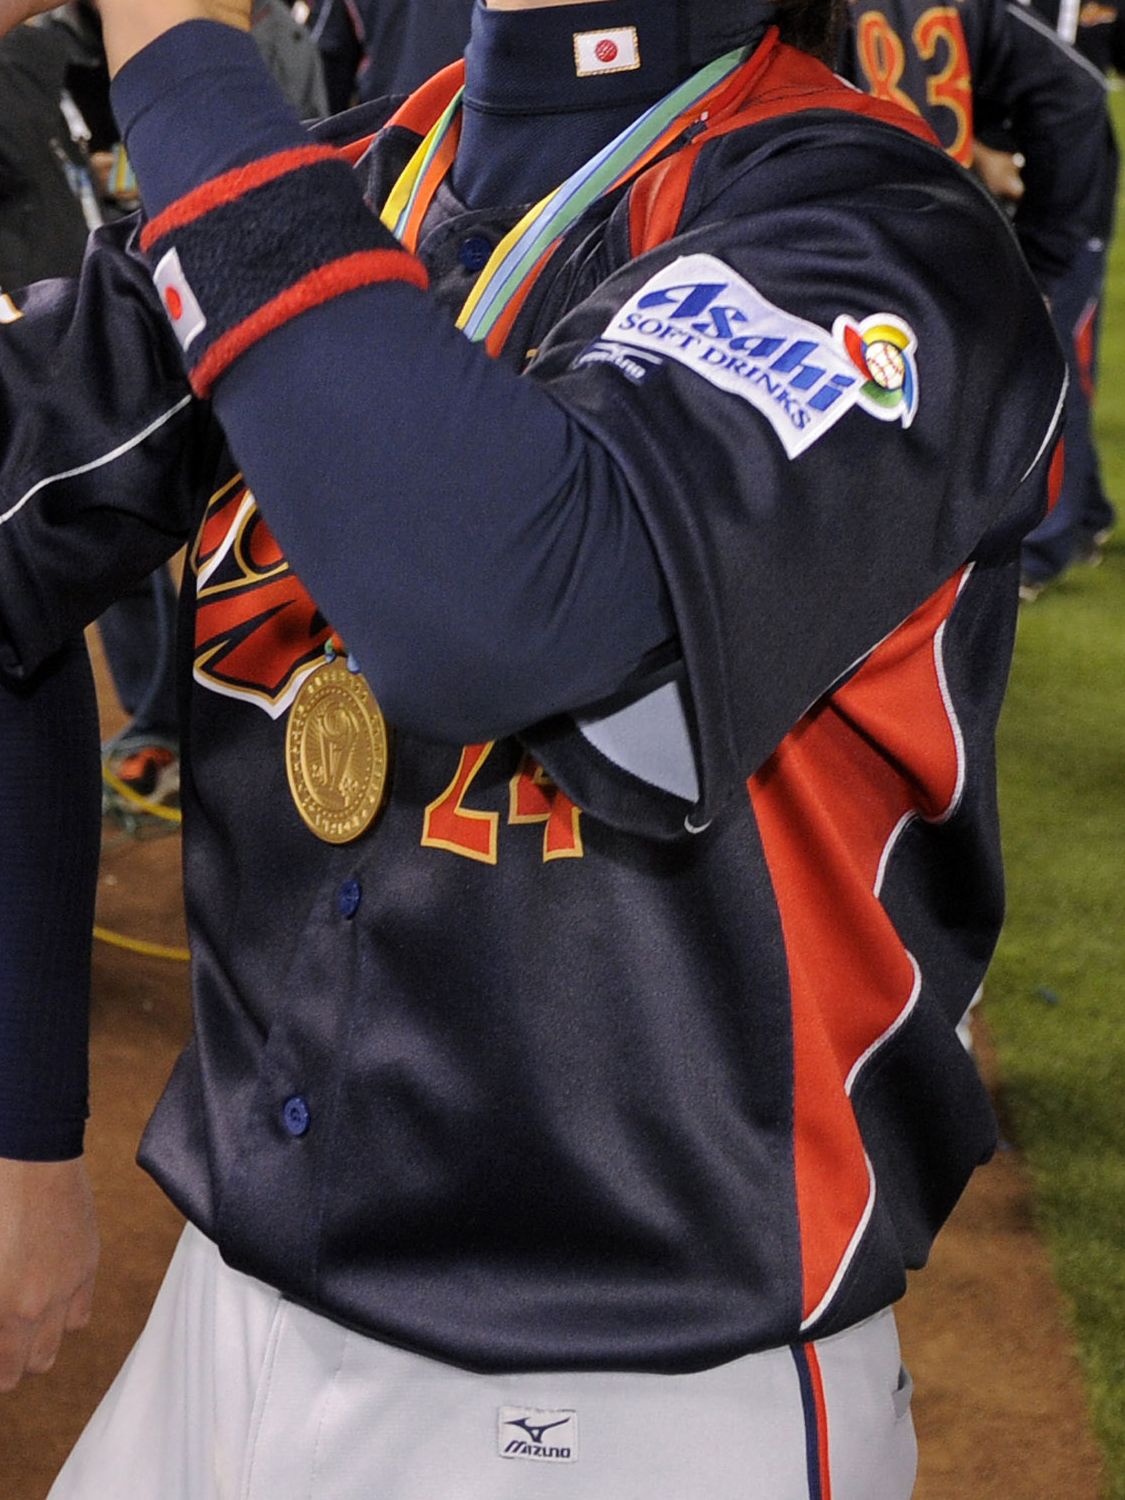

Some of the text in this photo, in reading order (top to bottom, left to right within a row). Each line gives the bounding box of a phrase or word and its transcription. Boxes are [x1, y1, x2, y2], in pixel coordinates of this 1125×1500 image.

[617, 312, 812, 431] SOFT DRINKS
[636, 283, 856, 412] Asahi
